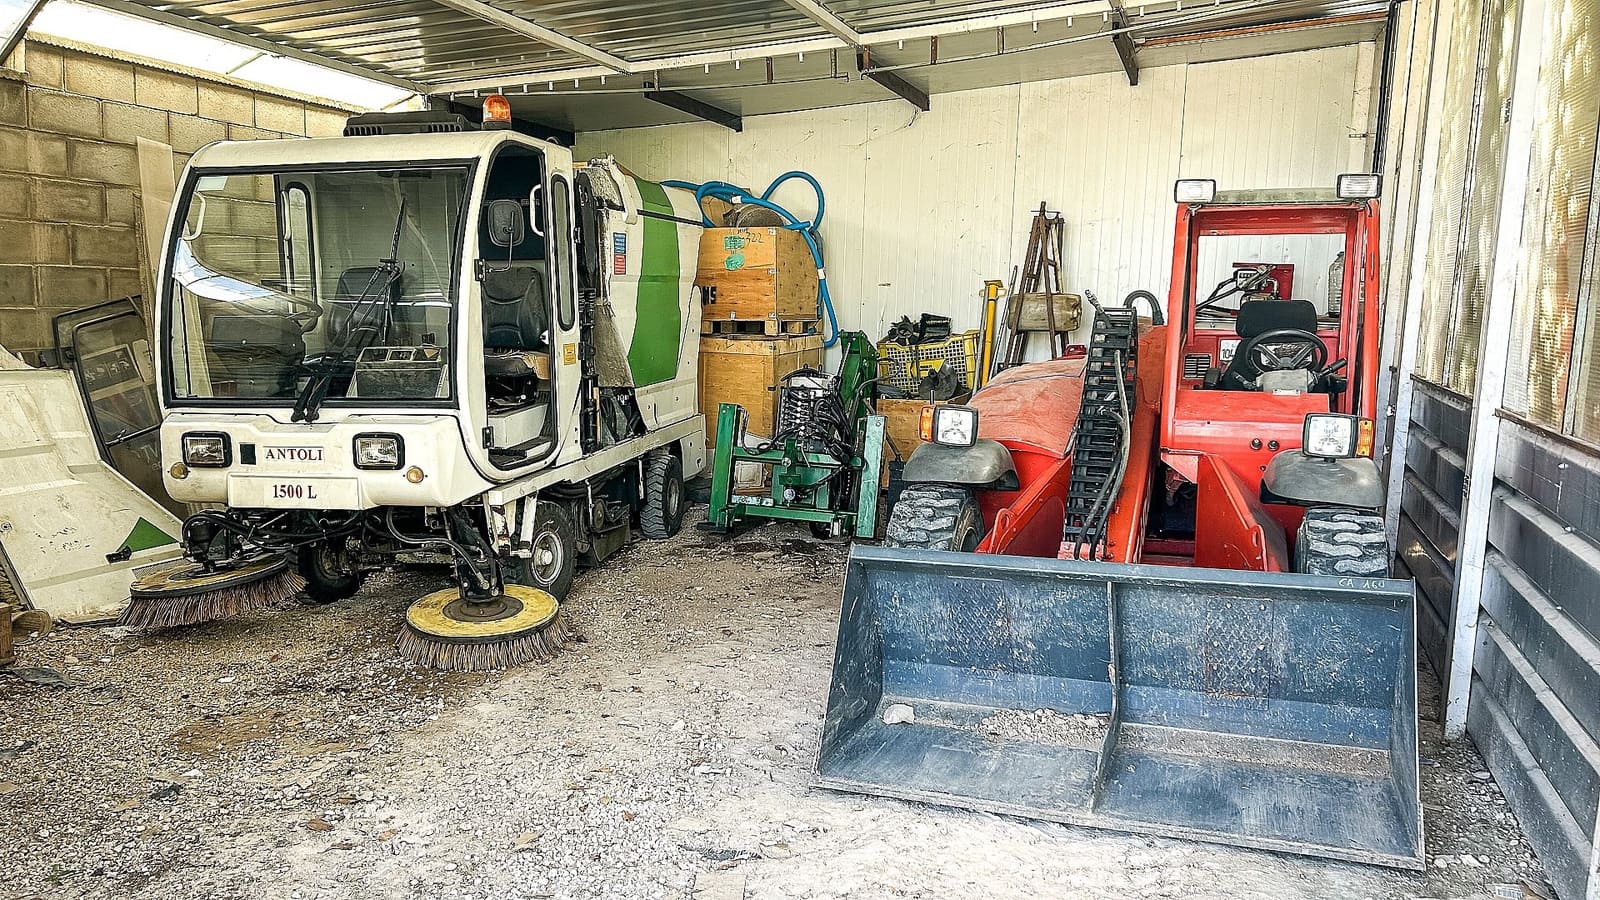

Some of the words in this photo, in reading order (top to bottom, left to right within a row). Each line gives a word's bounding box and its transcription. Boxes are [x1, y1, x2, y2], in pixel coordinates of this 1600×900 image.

[265, 448, 324, 461] ANTOLI
[273, 484, 303, 498] 1500
[308, 485, 317, 499] L
